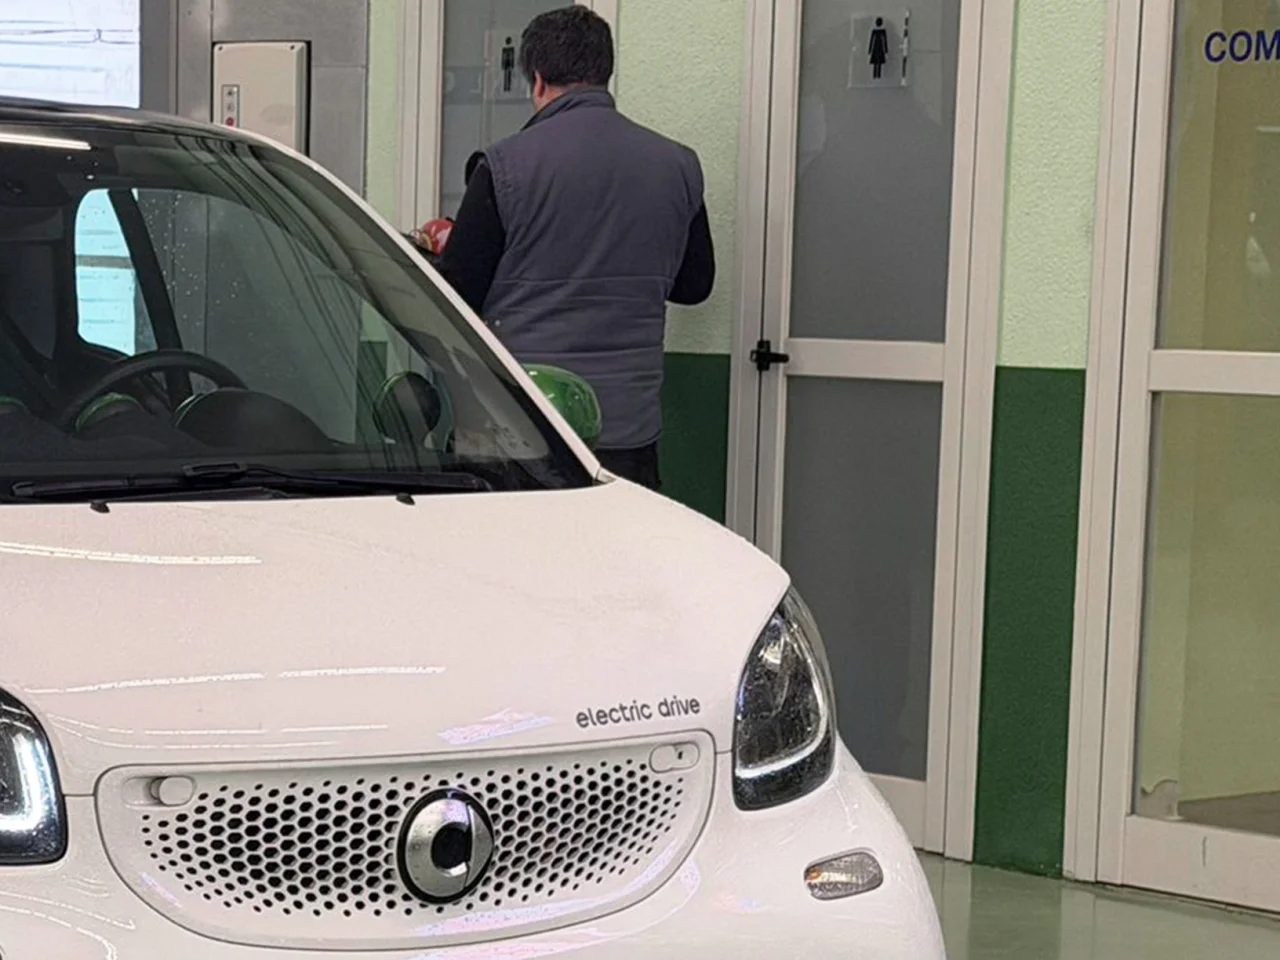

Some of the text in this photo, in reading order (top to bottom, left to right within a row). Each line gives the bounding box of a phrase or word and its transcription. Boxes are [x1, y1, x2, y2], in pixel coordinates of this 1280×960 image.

[1205, 30, 1280, 62] COM
[576, 695, 700, 728] electric drive
